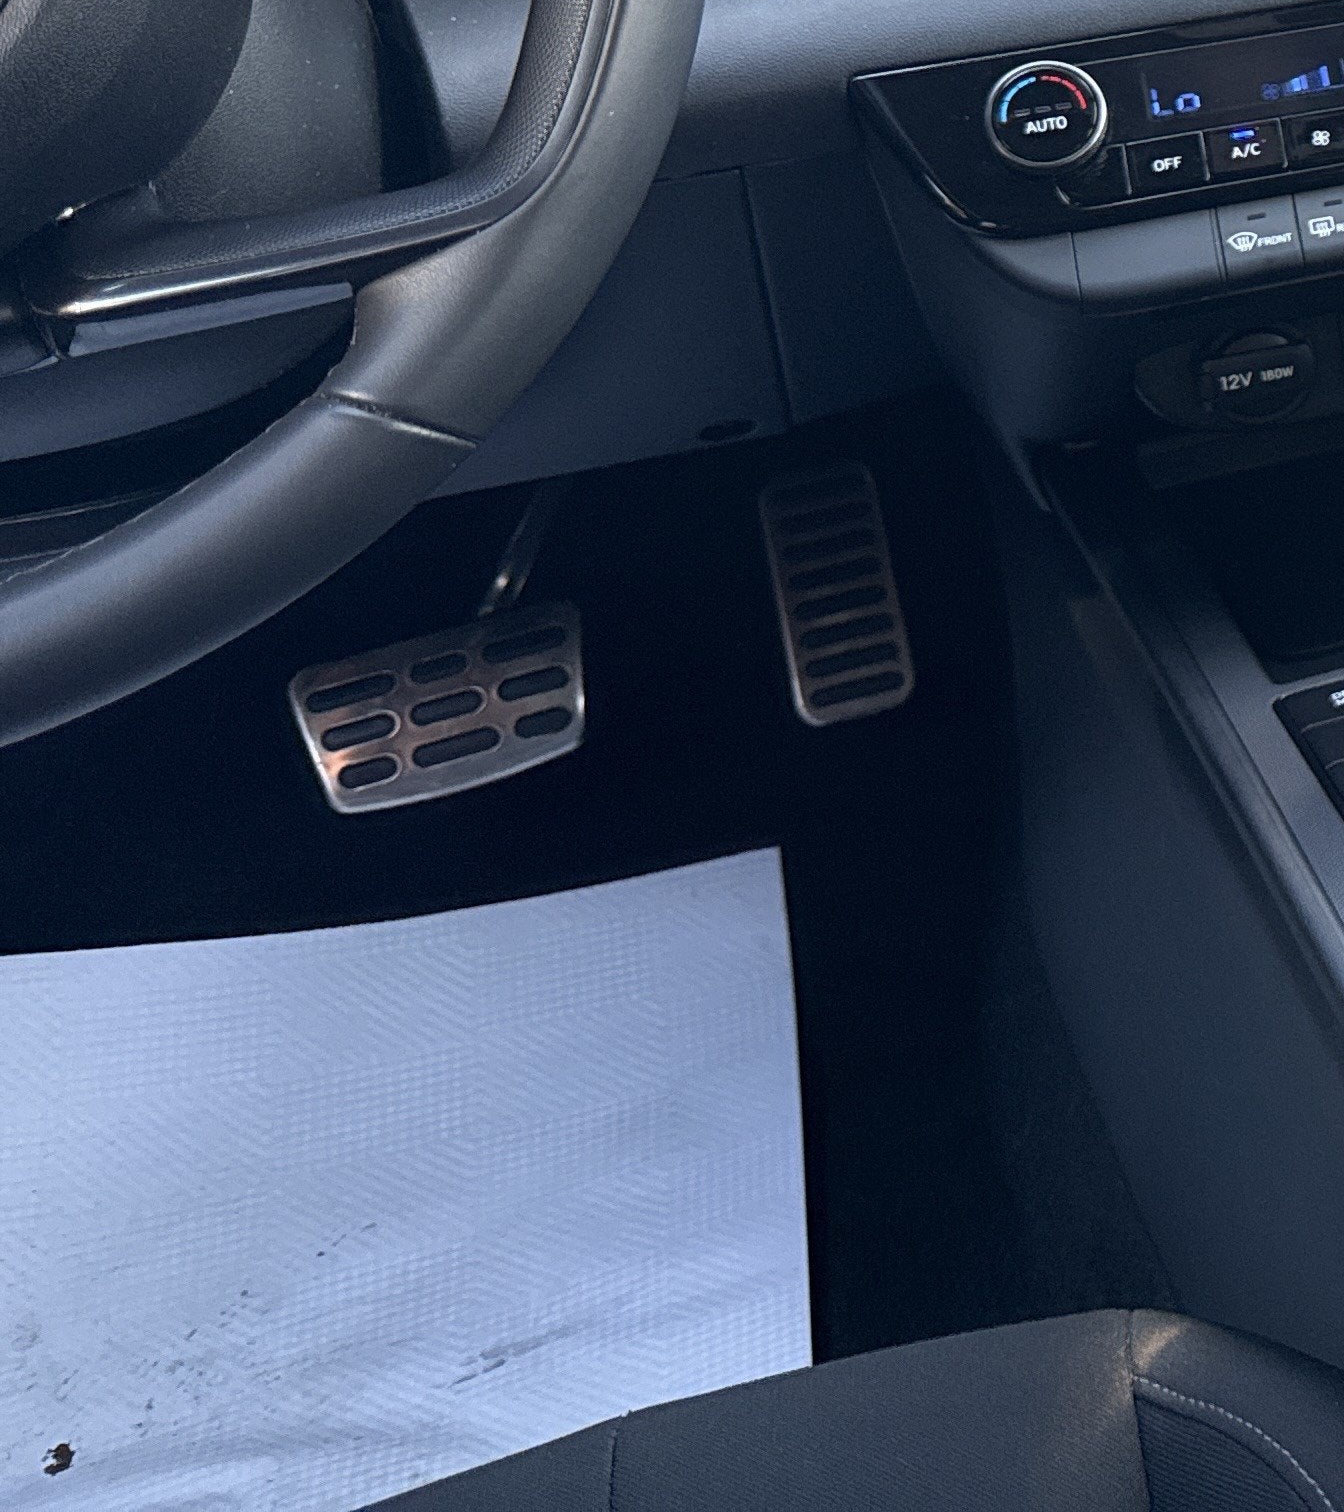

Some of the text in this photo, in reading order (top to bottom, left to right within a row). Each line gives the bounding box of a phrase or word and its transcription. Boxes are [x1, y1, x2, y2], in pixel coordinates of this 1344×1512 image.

[1150, 88, 1202, 117] Lo
[1024, 115, 1069, 136] AUTO
[1230, 142, 1263, 161] A/C
[1151, 156, 1183, 174] OFF
[1257, 232, 1293, 248] FRONT
[1219, 370, 1254, 392] 12V
